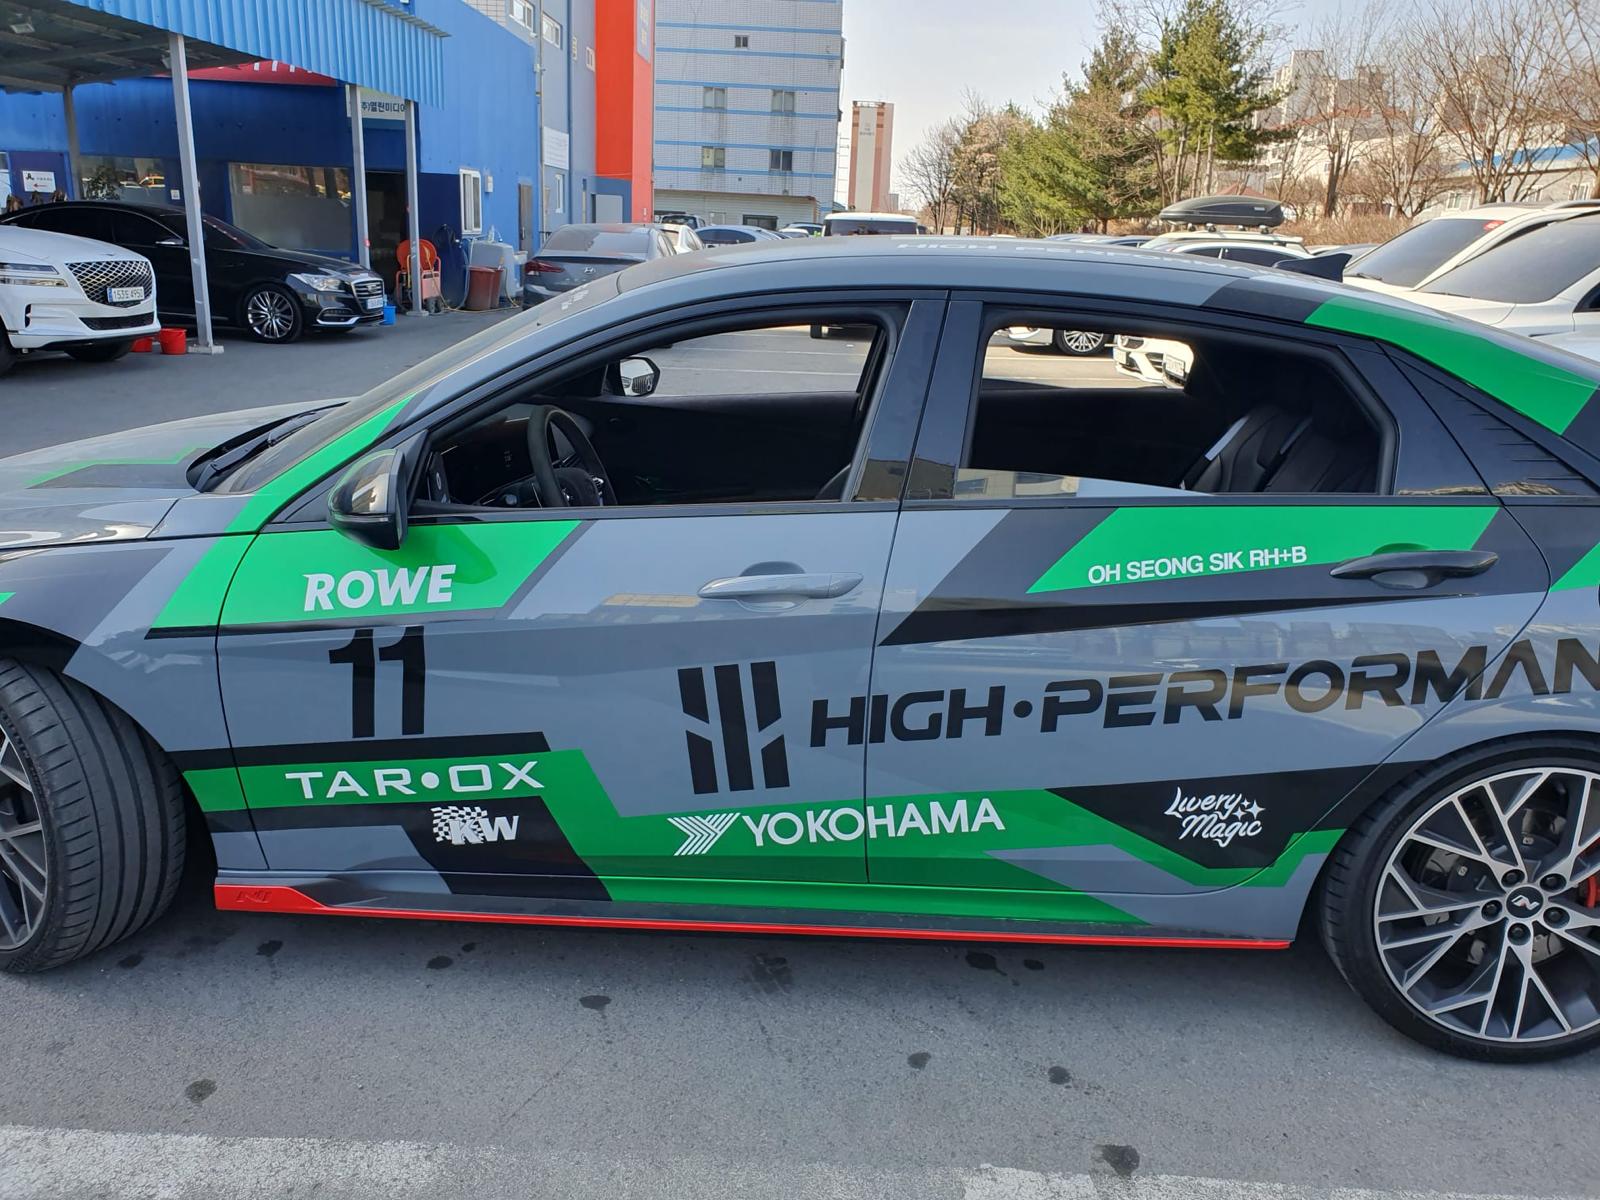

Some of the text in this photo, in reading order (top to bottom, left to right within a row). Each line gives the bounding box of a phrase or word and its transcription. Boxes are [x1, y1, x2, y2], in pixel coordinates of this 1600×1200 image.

[361, 101, 408, 113] 주)열린미디어
[1088, 545, 1308, 584] OH SEONG SIK RH+B
[303, 564, 456, 612] ROWE
[328, 625, 426, 739] 11
[448, 815, 520, 845] KW
[742, 798, 1006, 847] YOKOHAMA
[1178, 812, 1263, 848] Magic
